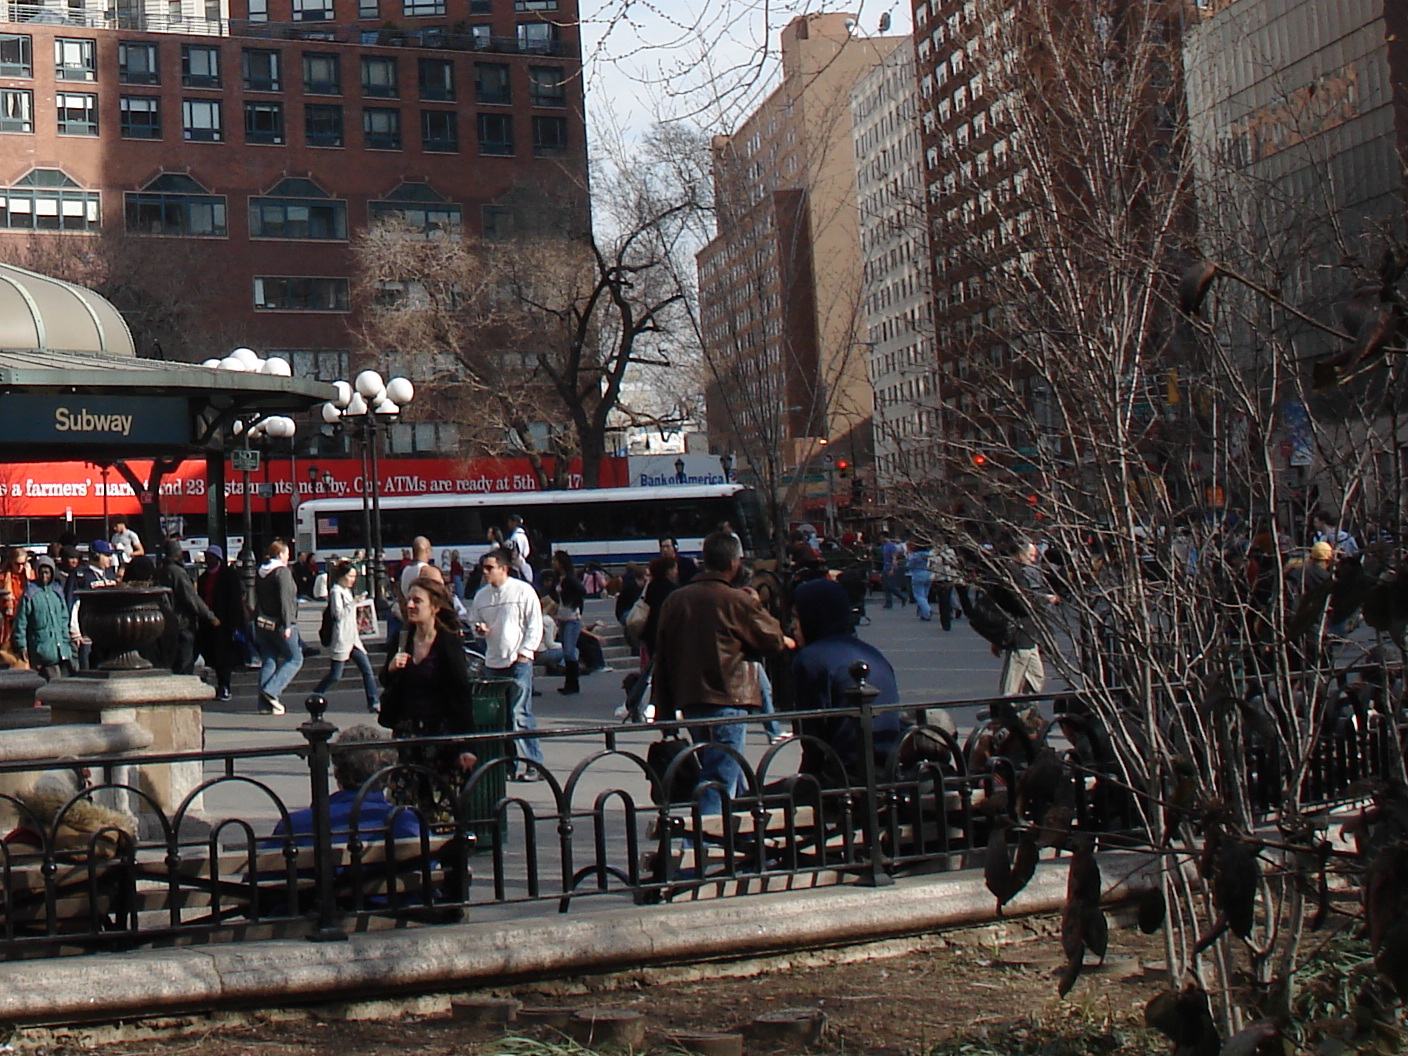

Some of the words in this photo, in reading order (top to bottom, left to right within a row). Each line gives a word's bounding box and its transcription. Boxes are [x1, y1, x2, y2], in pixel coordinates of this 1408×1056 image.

[55, 407, 133, 436] Subway
[11, 483, 23, 497] a
[94, 479, 149, 497] markt
[186, 479, 205, 496] 23
[299, 477, 350, 496] neaby.
[384, 475, 427, 492] ATMs
[430, 479, 453, 492] are
[456, 475, 493, 494] ready
[496, 476, 510, 490] at
[513, 474, 535, 490] 5th
[640, 473, 667, 486] Bank
[683, 472, 724, 485] America
